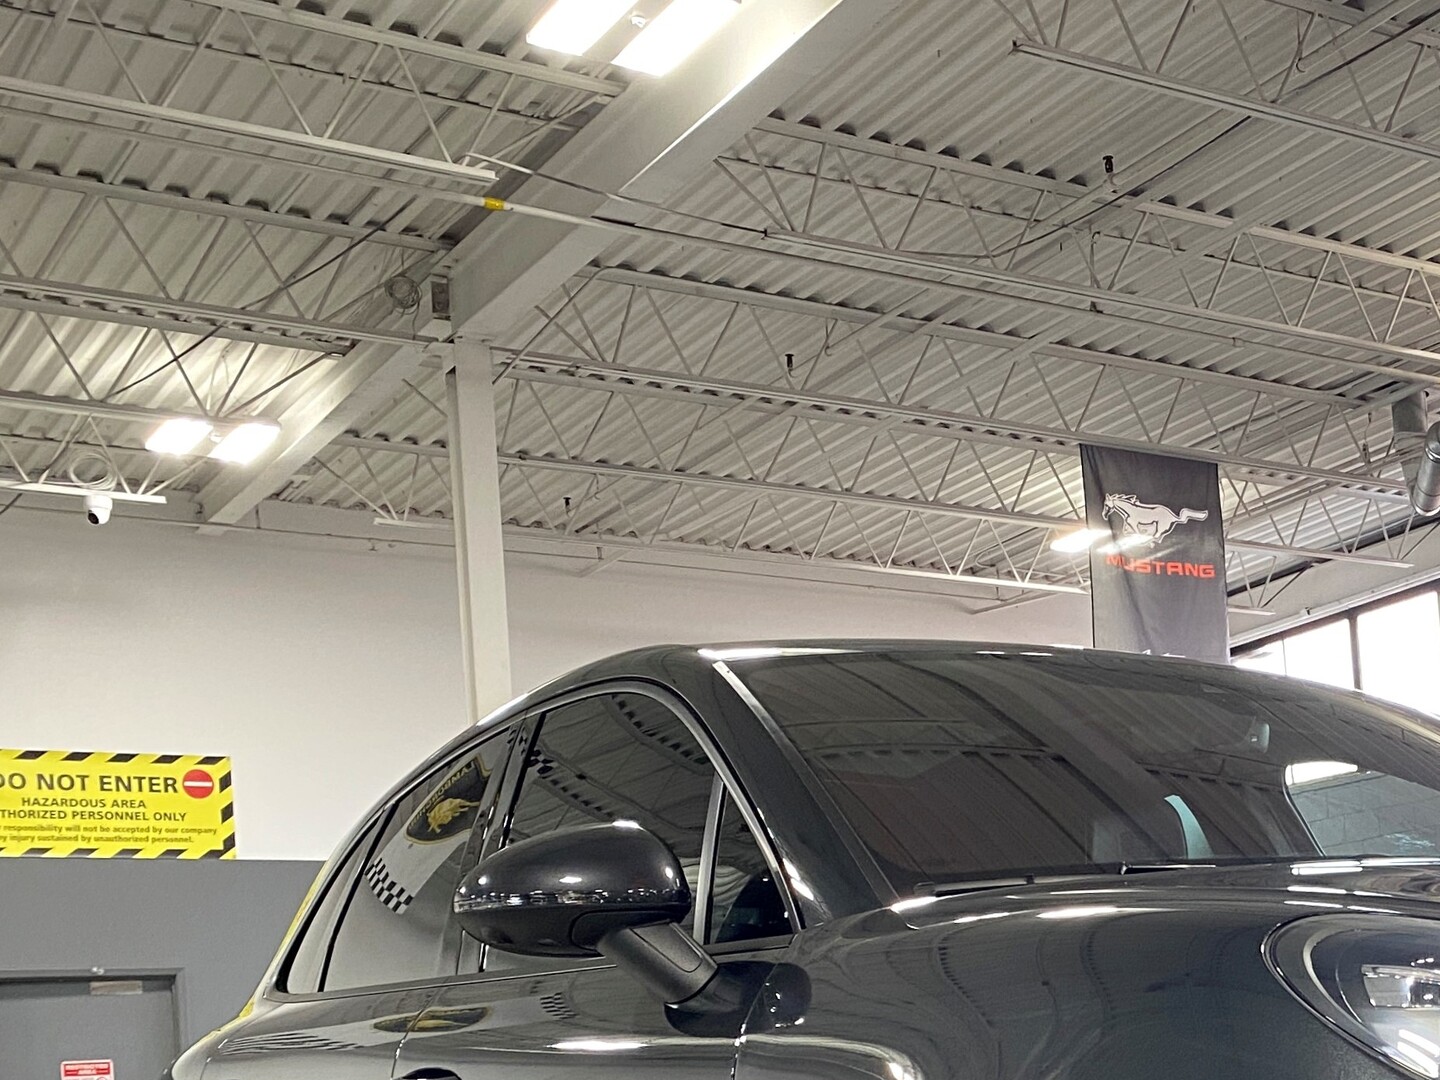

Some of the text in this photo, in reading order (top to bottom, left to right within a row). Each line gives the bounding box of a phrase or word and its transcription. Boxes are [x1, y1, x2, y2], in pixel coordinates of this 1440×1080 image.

[1106, 553, 1216, 579] MUSTANG
[37, 774, 90, 791] NOT
[99, 775, 179, 793] ENTER
[21, 797, 147, 809] HAZARDOUS AREA
[71, 811, 149, 821] PERSONNEL
[154, 812, 187, 822] ONLY
[112, 826, 150, 834] accepted
